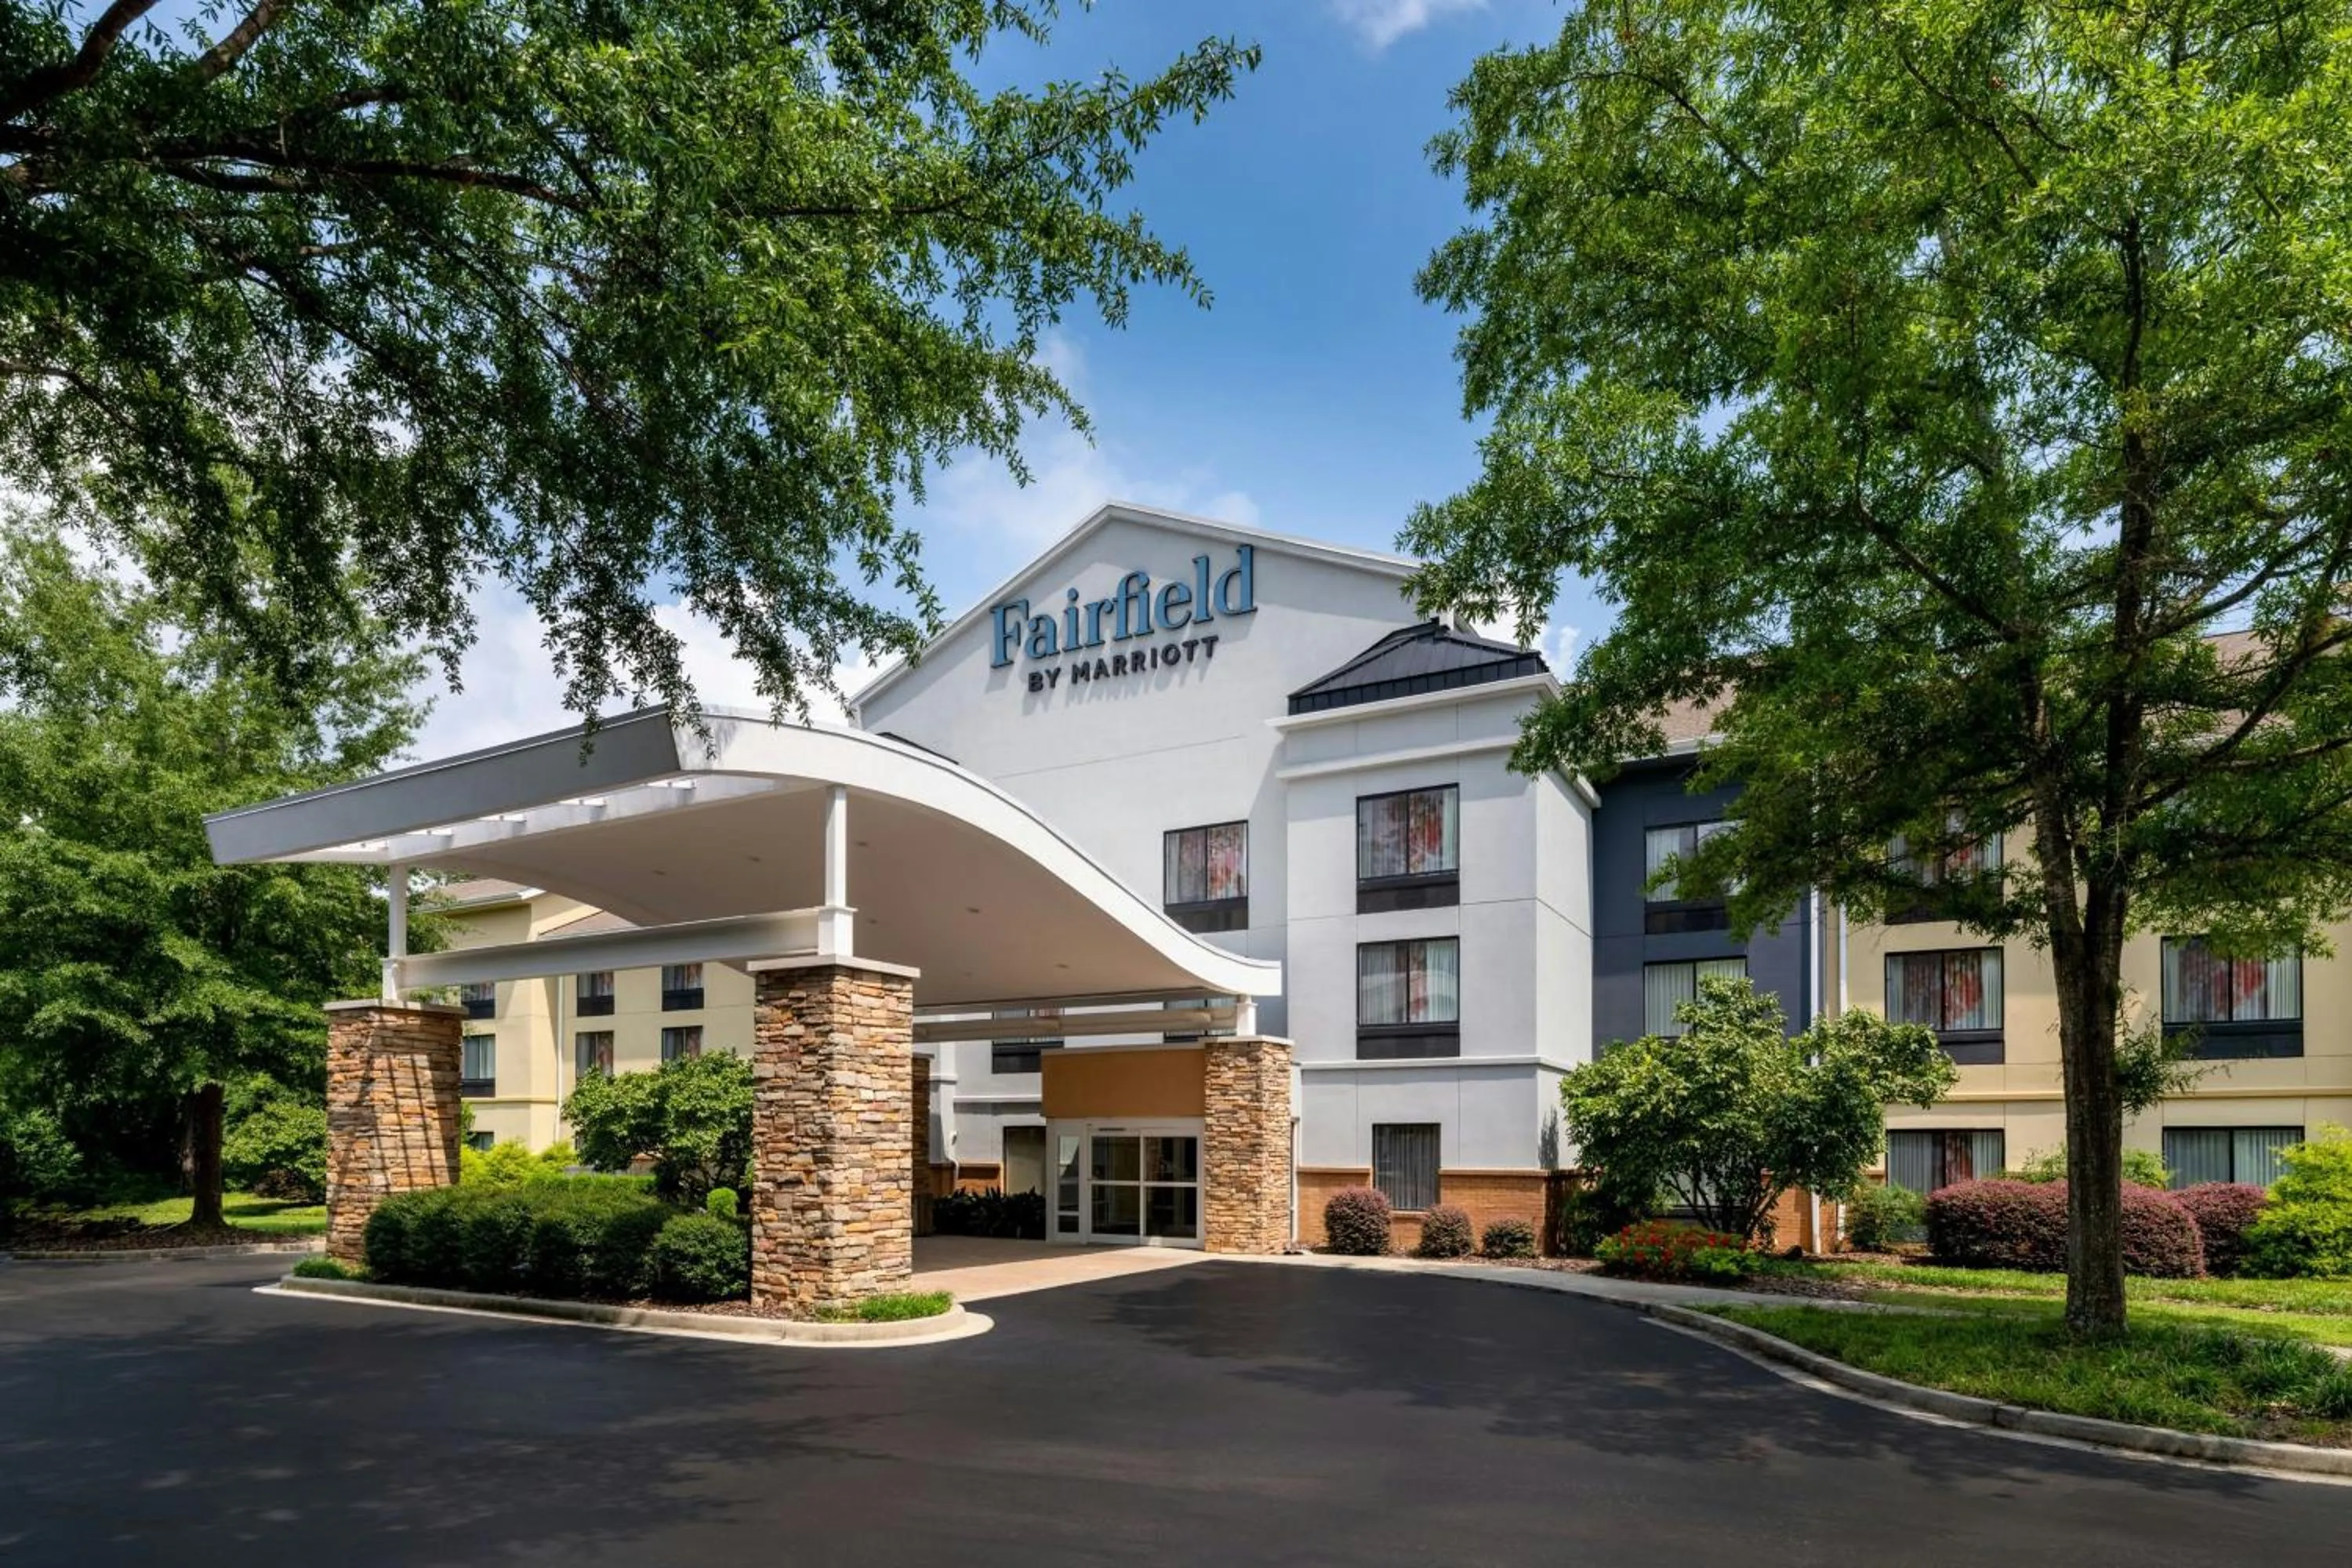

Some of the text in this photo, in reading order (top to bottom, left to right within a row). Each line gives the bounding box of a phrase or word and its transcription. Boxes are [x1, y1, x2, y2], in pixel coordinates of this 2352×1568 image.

[990, 544, 1258, 670] Fairfield
[1028, 635, 1219, 692] BY MARRIOTT
